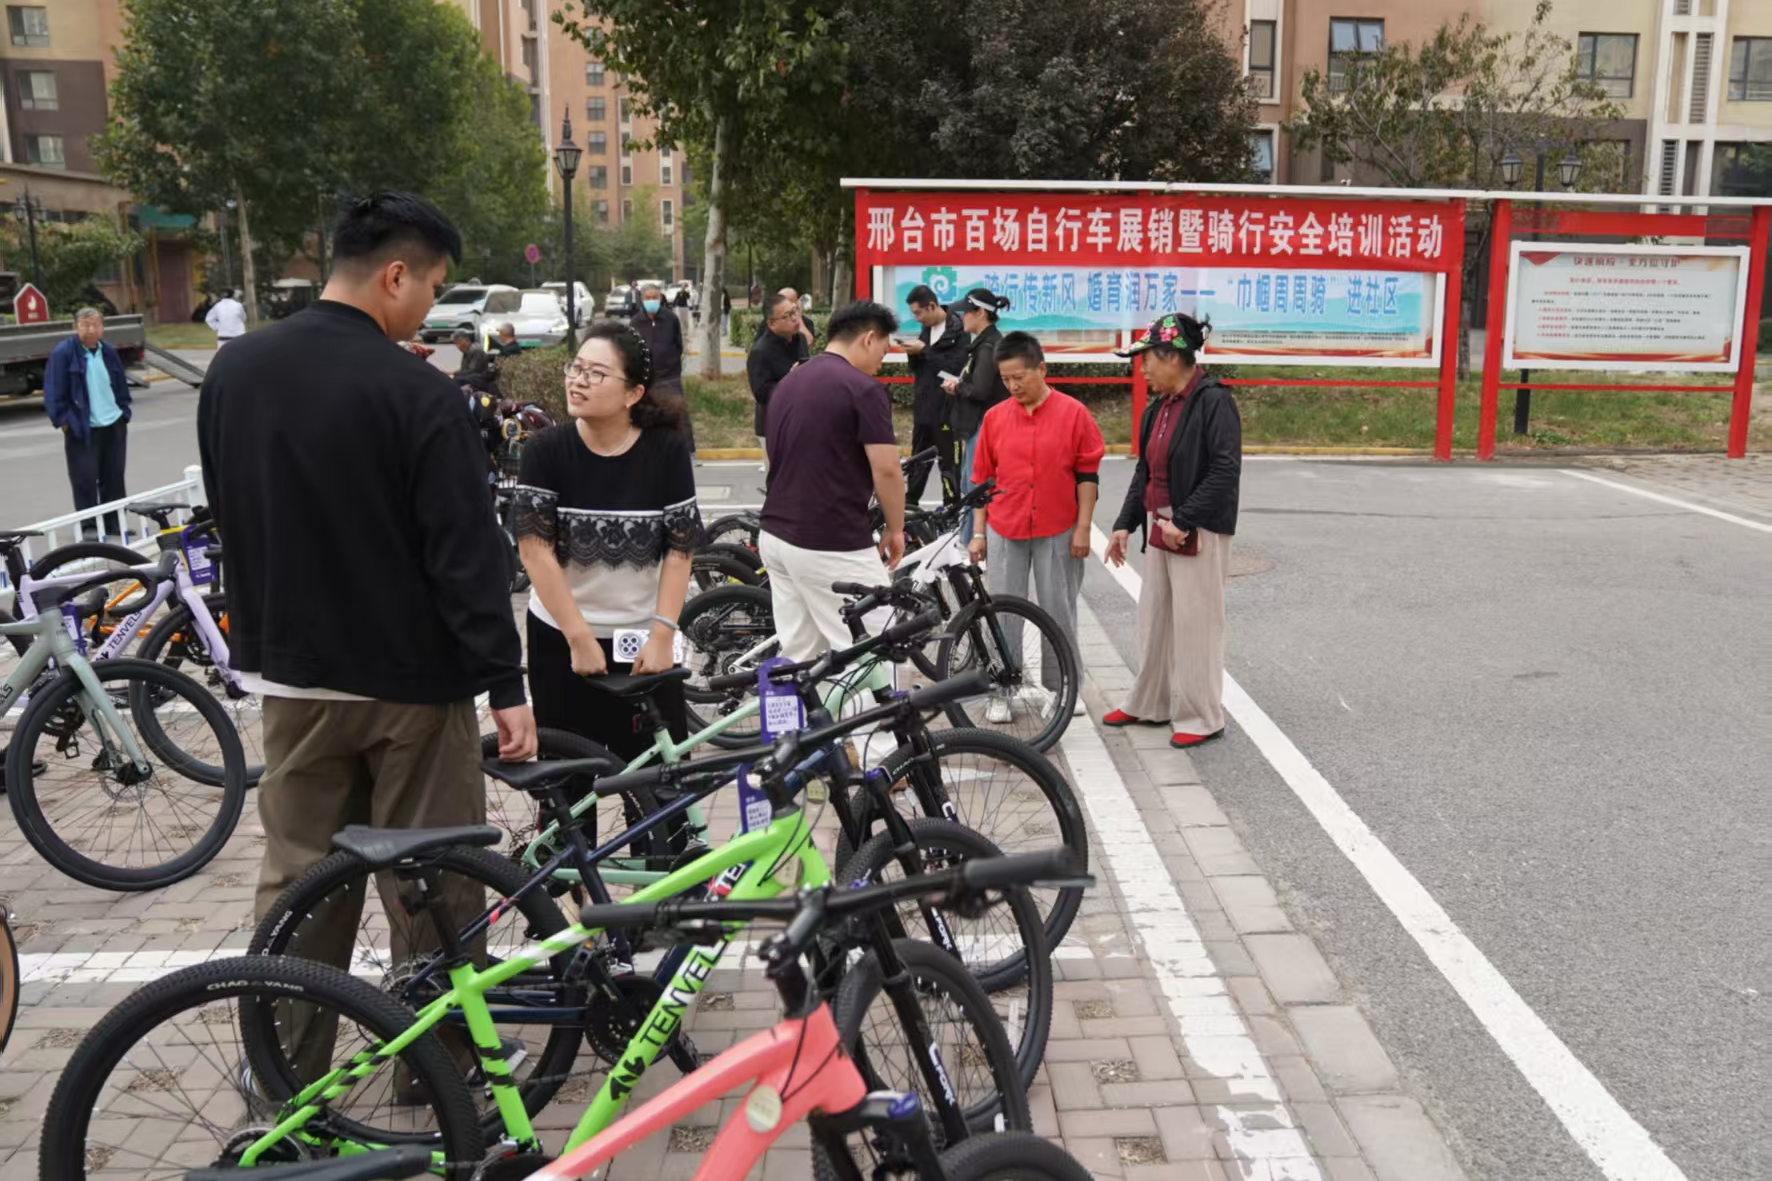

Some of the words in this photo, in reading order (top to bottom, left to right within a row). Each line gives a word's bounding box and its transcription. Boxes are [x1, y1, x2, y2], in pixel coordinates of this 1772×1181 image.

[867, 206, 1443, 259] 邢台市百场自行车展销暨骑行安全培训活动
[1347, 275, 1399, 315] 进社区
[206, 980, 249, 991] CHAO
[263, 980, 305, 992] YANG
[640, 938, 729, 1047] TENVEL
